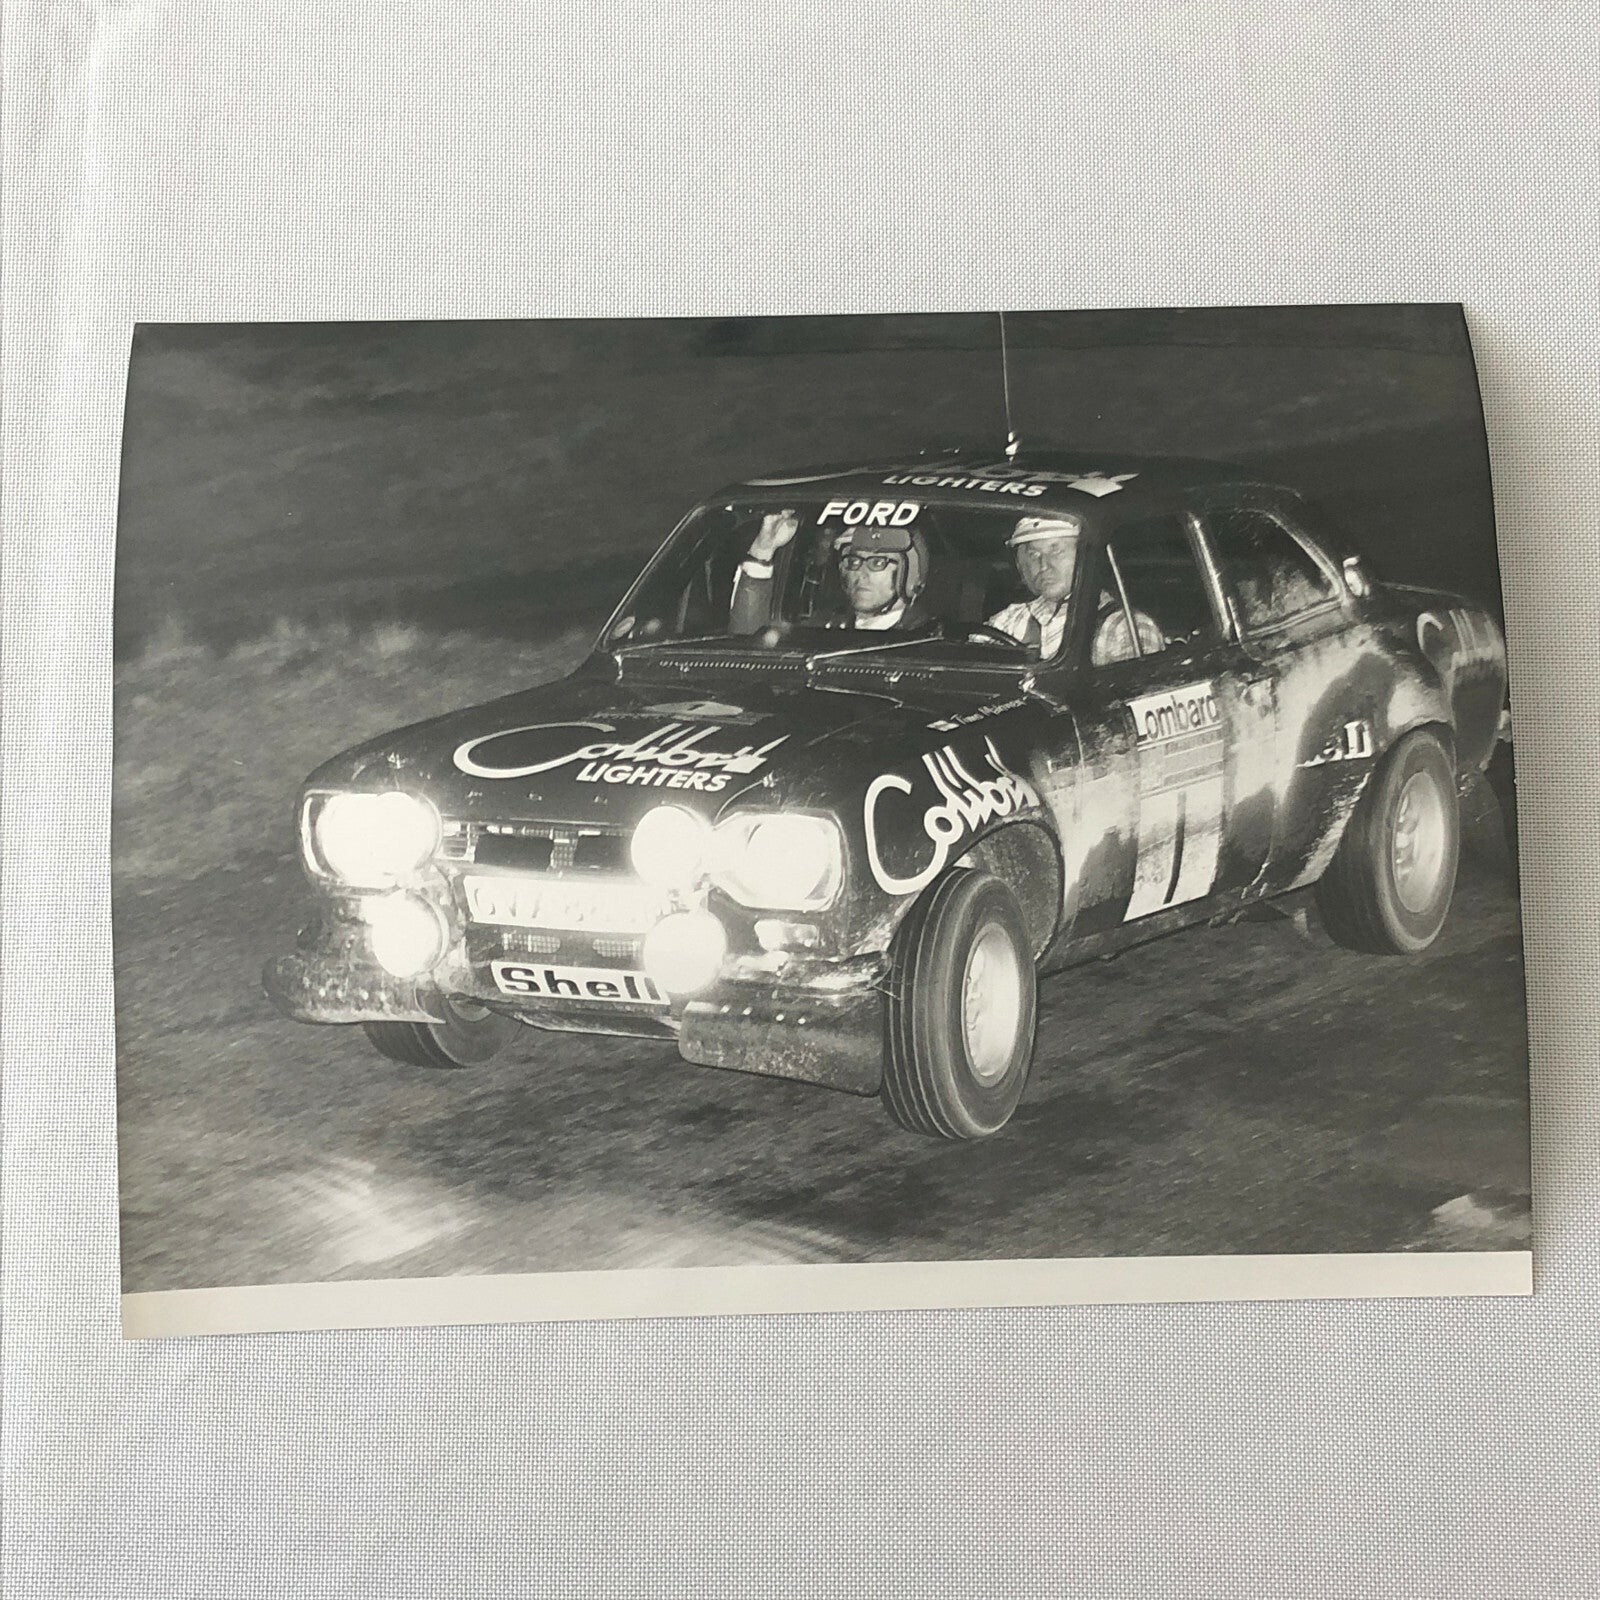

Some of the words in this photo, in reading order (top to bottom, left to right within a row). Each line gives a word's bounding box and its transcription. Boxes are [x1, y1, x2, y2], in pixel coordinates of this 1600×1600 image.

[882, 474, 1049, 498] LIGHTERS
[816, 500, 920, 527] FORD
[453, 722, 791, 779] Colibri
[575, 763, 733, 792] LIGHTERS
[500, 967, 662, 1001] Shell
